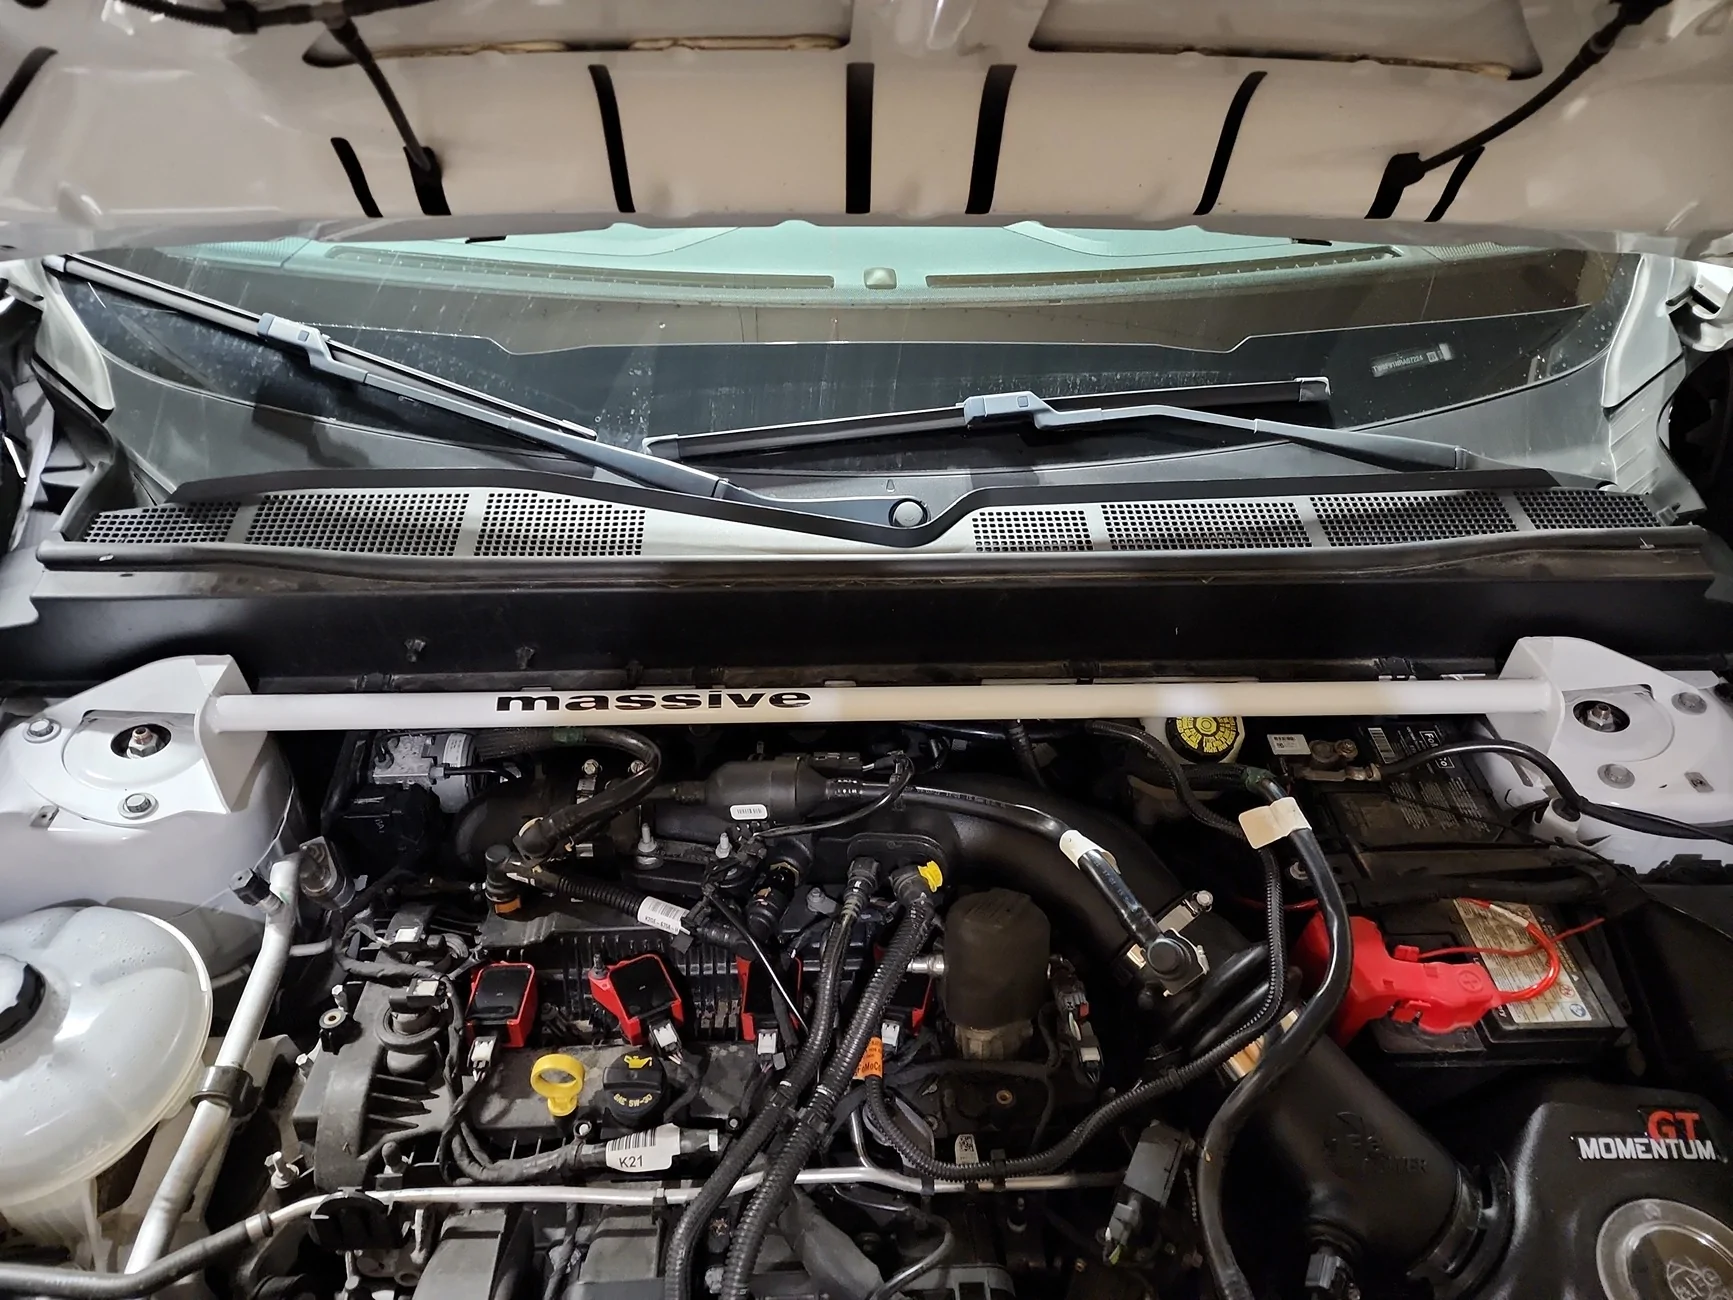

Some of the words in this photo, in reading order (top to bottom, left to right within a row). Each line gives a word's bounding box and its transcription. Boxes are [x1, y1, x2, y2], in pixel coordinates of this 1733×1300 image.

[496, 690, 812, 712] massive
[628, 1093, 653, 1107] 5W-30
[1647, 1110, 1700, 1141] GT
[1577, 1137, 1717, 1160] MOMENTUM
[619, 1155, 644, 1168] K21
